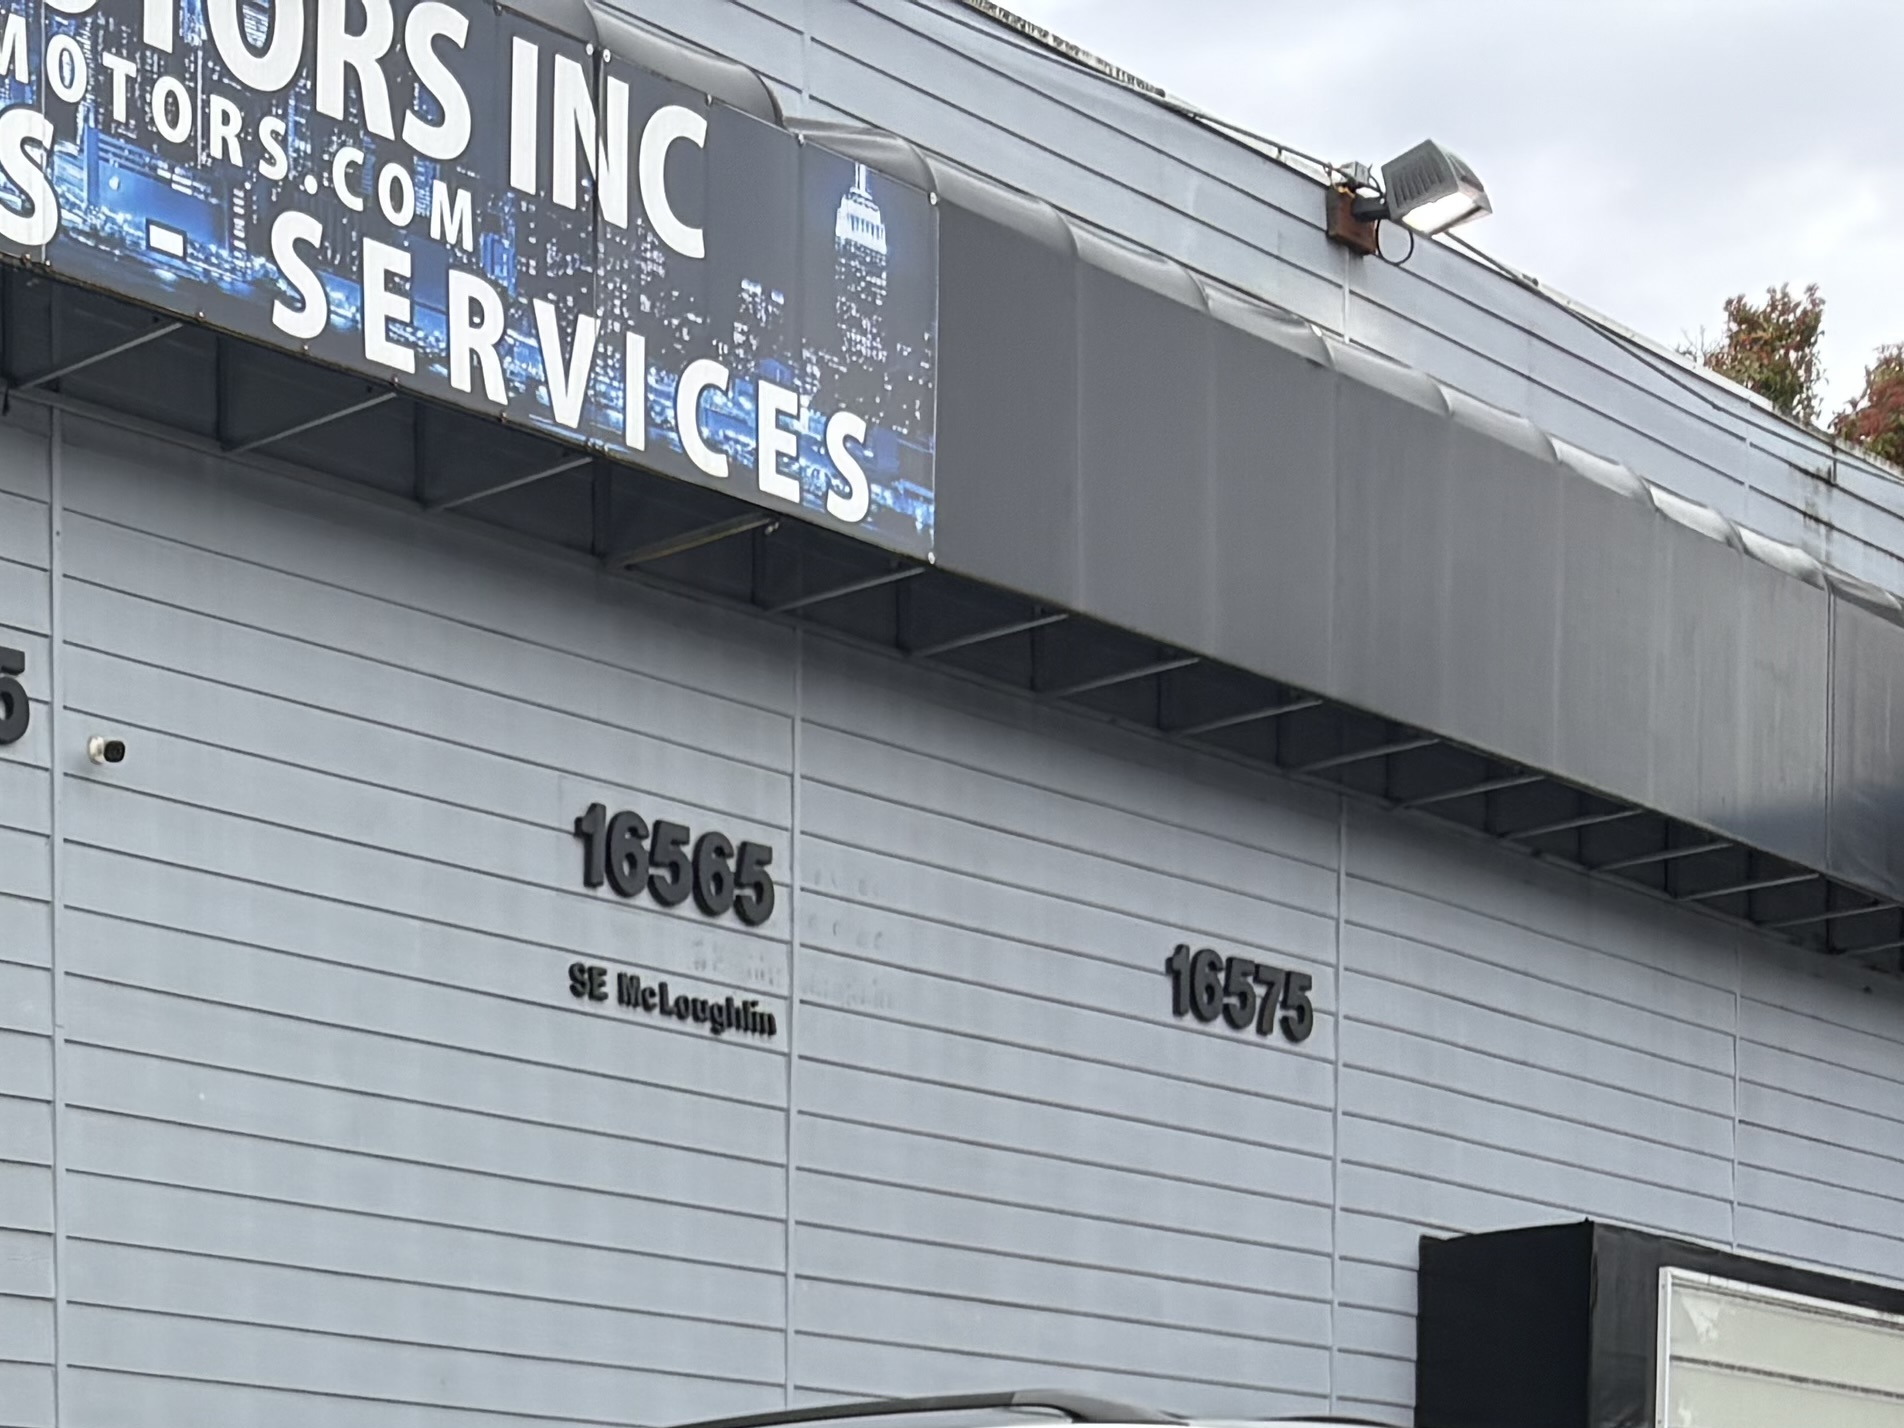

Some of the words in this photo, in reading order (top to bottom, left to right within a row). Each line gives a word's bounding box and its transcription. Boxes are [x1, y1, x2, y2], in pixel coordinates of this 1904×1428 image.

[43, 0, 472, 160] ORS
[510, 36, 708, 259] INC
[271, 210, 870, 523] SERVICES
[573, 801, 775, 927] 16565
[568, 962, 609, 1002] SE
[617, 972, 777, 1036] McLoughlin
[1166, 943, 1314, 1044] 16575
